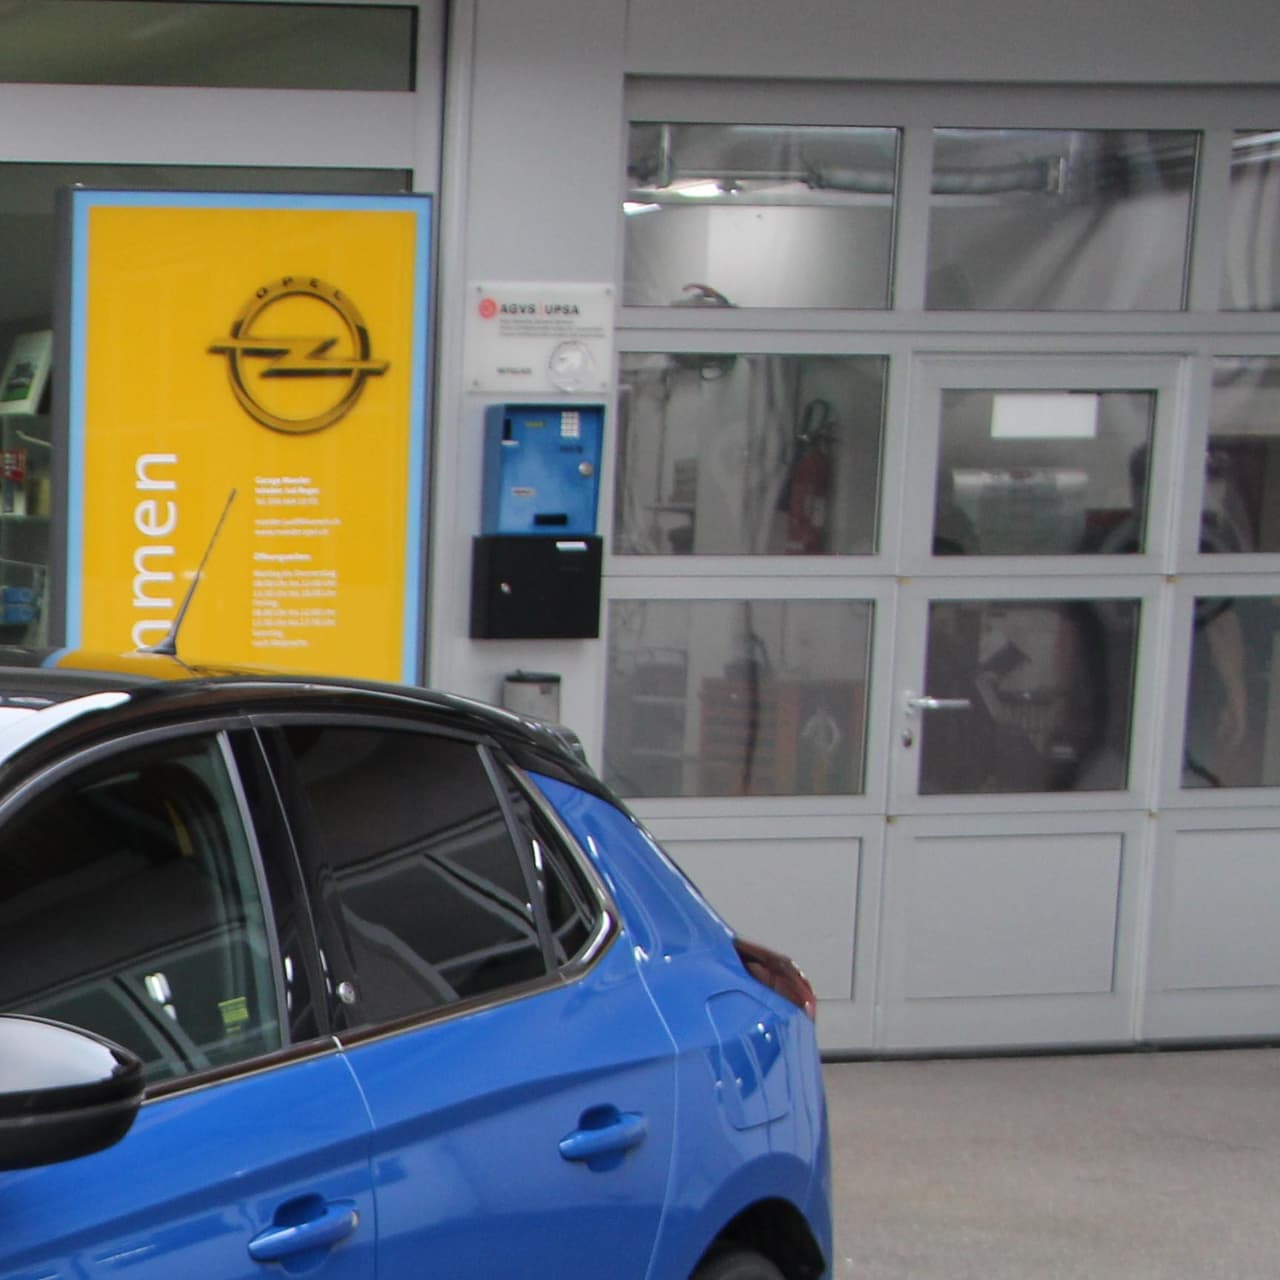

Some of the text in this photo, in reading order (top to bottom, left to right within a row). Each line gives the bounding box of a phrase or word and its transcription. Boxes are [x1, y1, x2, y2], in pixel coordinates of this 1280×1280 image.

[256, 275, 343, 299] OPEL
[500, 303, 579, 315] AGVS UPSA
